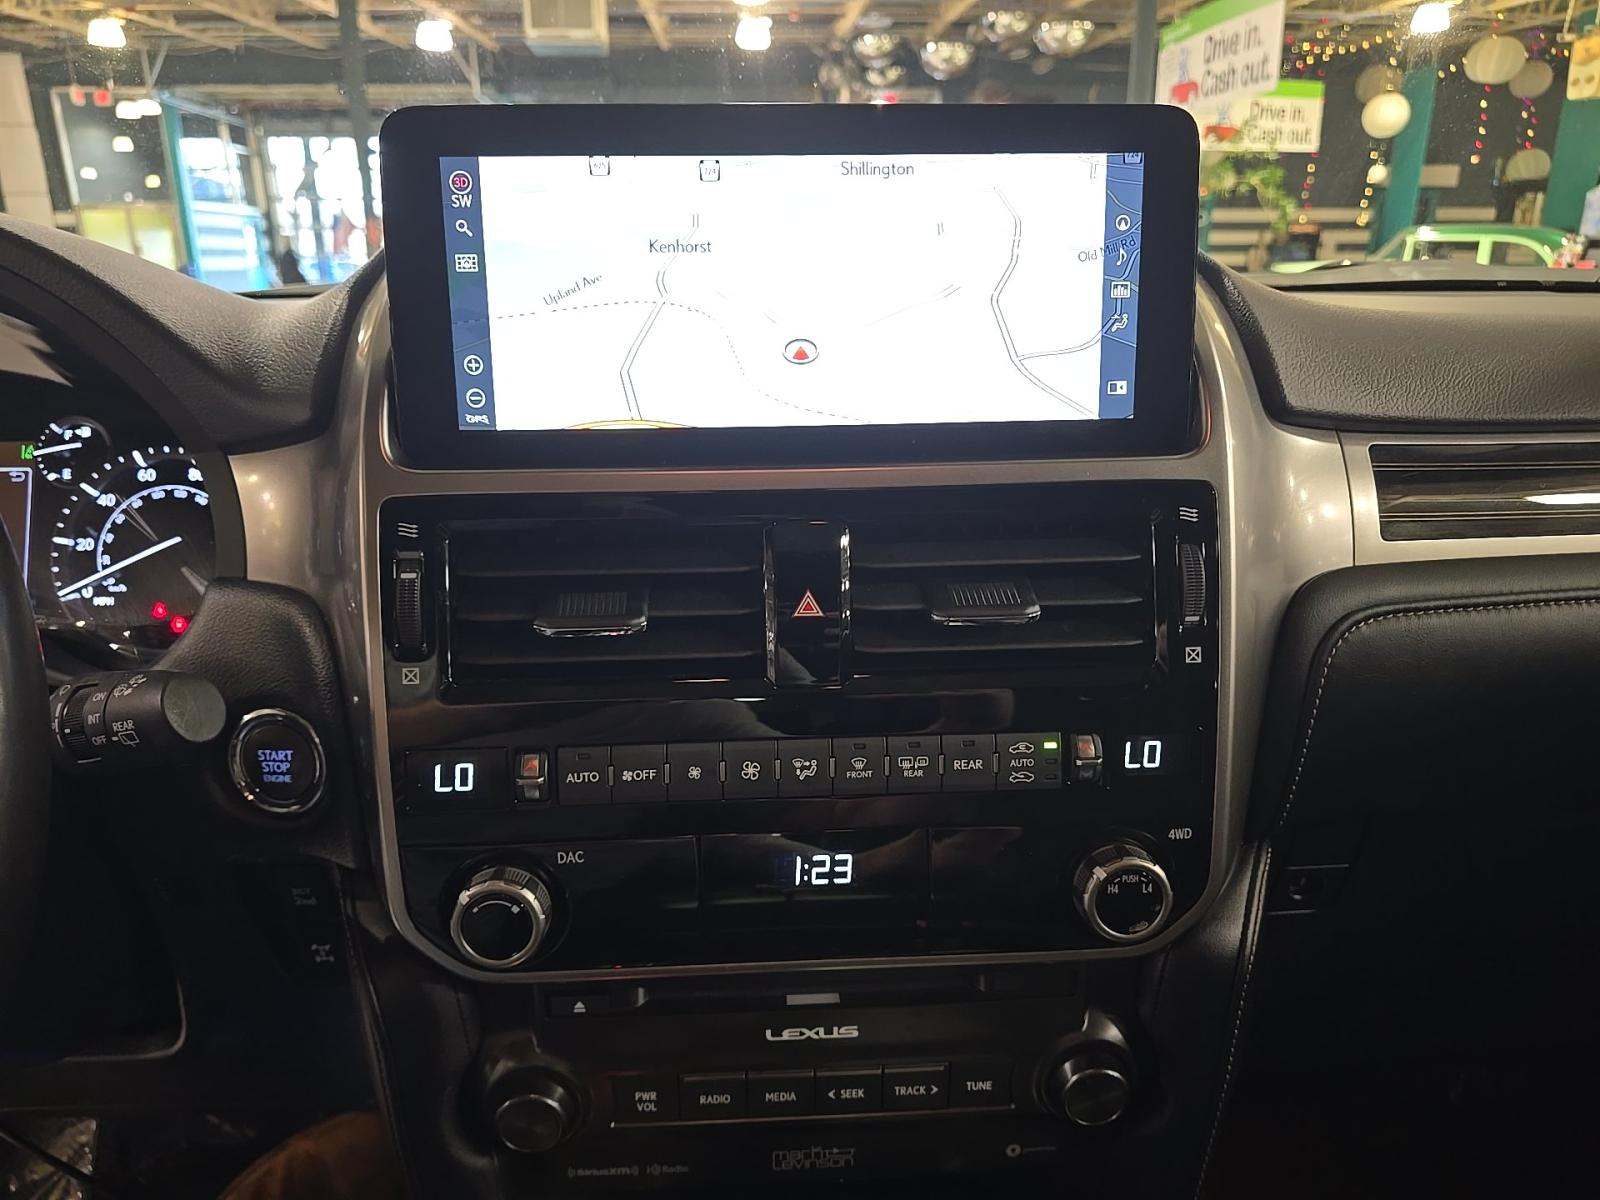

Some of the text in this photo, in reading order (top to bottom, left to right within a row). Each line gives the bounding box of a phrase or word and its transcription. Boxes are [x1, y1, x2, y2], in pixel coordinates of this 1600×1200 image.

[1203, 29, 1240, 64] Drive
[1201, 63, 1236, 97] Cash
[1249, 100, 1286, 121] Drive
[840, 161, 915, 179] Shillington
[453, 176, 468, 189] 3D
[451, 194, 473, 208] SW
[649, 239, 712, 254] Kenhorst
[1077, 235, 1136, 262] Old Mill Rd
[543, 273, 603, 306] Upland Ave
[137, 468, 157, 482] 60
[96, 493, 117, 507] 40
[75, 538, 95, 551] 20
[92, 691, 107, 702] ON
[87, 713, 101, 725] INT
[112, 719, 135, 733] REAR
[91, 734, 107, 746] OFF
[257, 749, 294, 762] START
[1124, 740, 1162, 769] LO
[261, 761, 291, 773] STOP
[953, 758, 984, 771] REAR
[1009, 757, 1035, 768] AUTO
[434, 762, 475, 793] LO
[565, 770, 600, 785] AUTO
[633, 768, 657, 782] OFF
[846, 769, 873, 780] FRONT
[902, 768, 925, 778] REAR
[1168, 827, 1193, 841] 4WD
[556, 851, 585, 865] DAC
[794, 853, 854, 886] 1:23
[1121, 874, 1139, 884] PUSH
[1107, 883, 1119, 895] H4
[1141, 882, 1153, 894] L4
[765, 1025, 859, 1041] LEXUS
[894, 1085, 927, 1096] TRACK
[966, 1080, 993, 1091] TUNE
[634, 1090, 657, 1102] PWR
[699, 1093, 731, 1105] RADIO
[765, 1090, 797, 1102] MEDIA
[840, 1088, 865, 1099] SEEK
[636, 1101, 658, 1112] VOL
